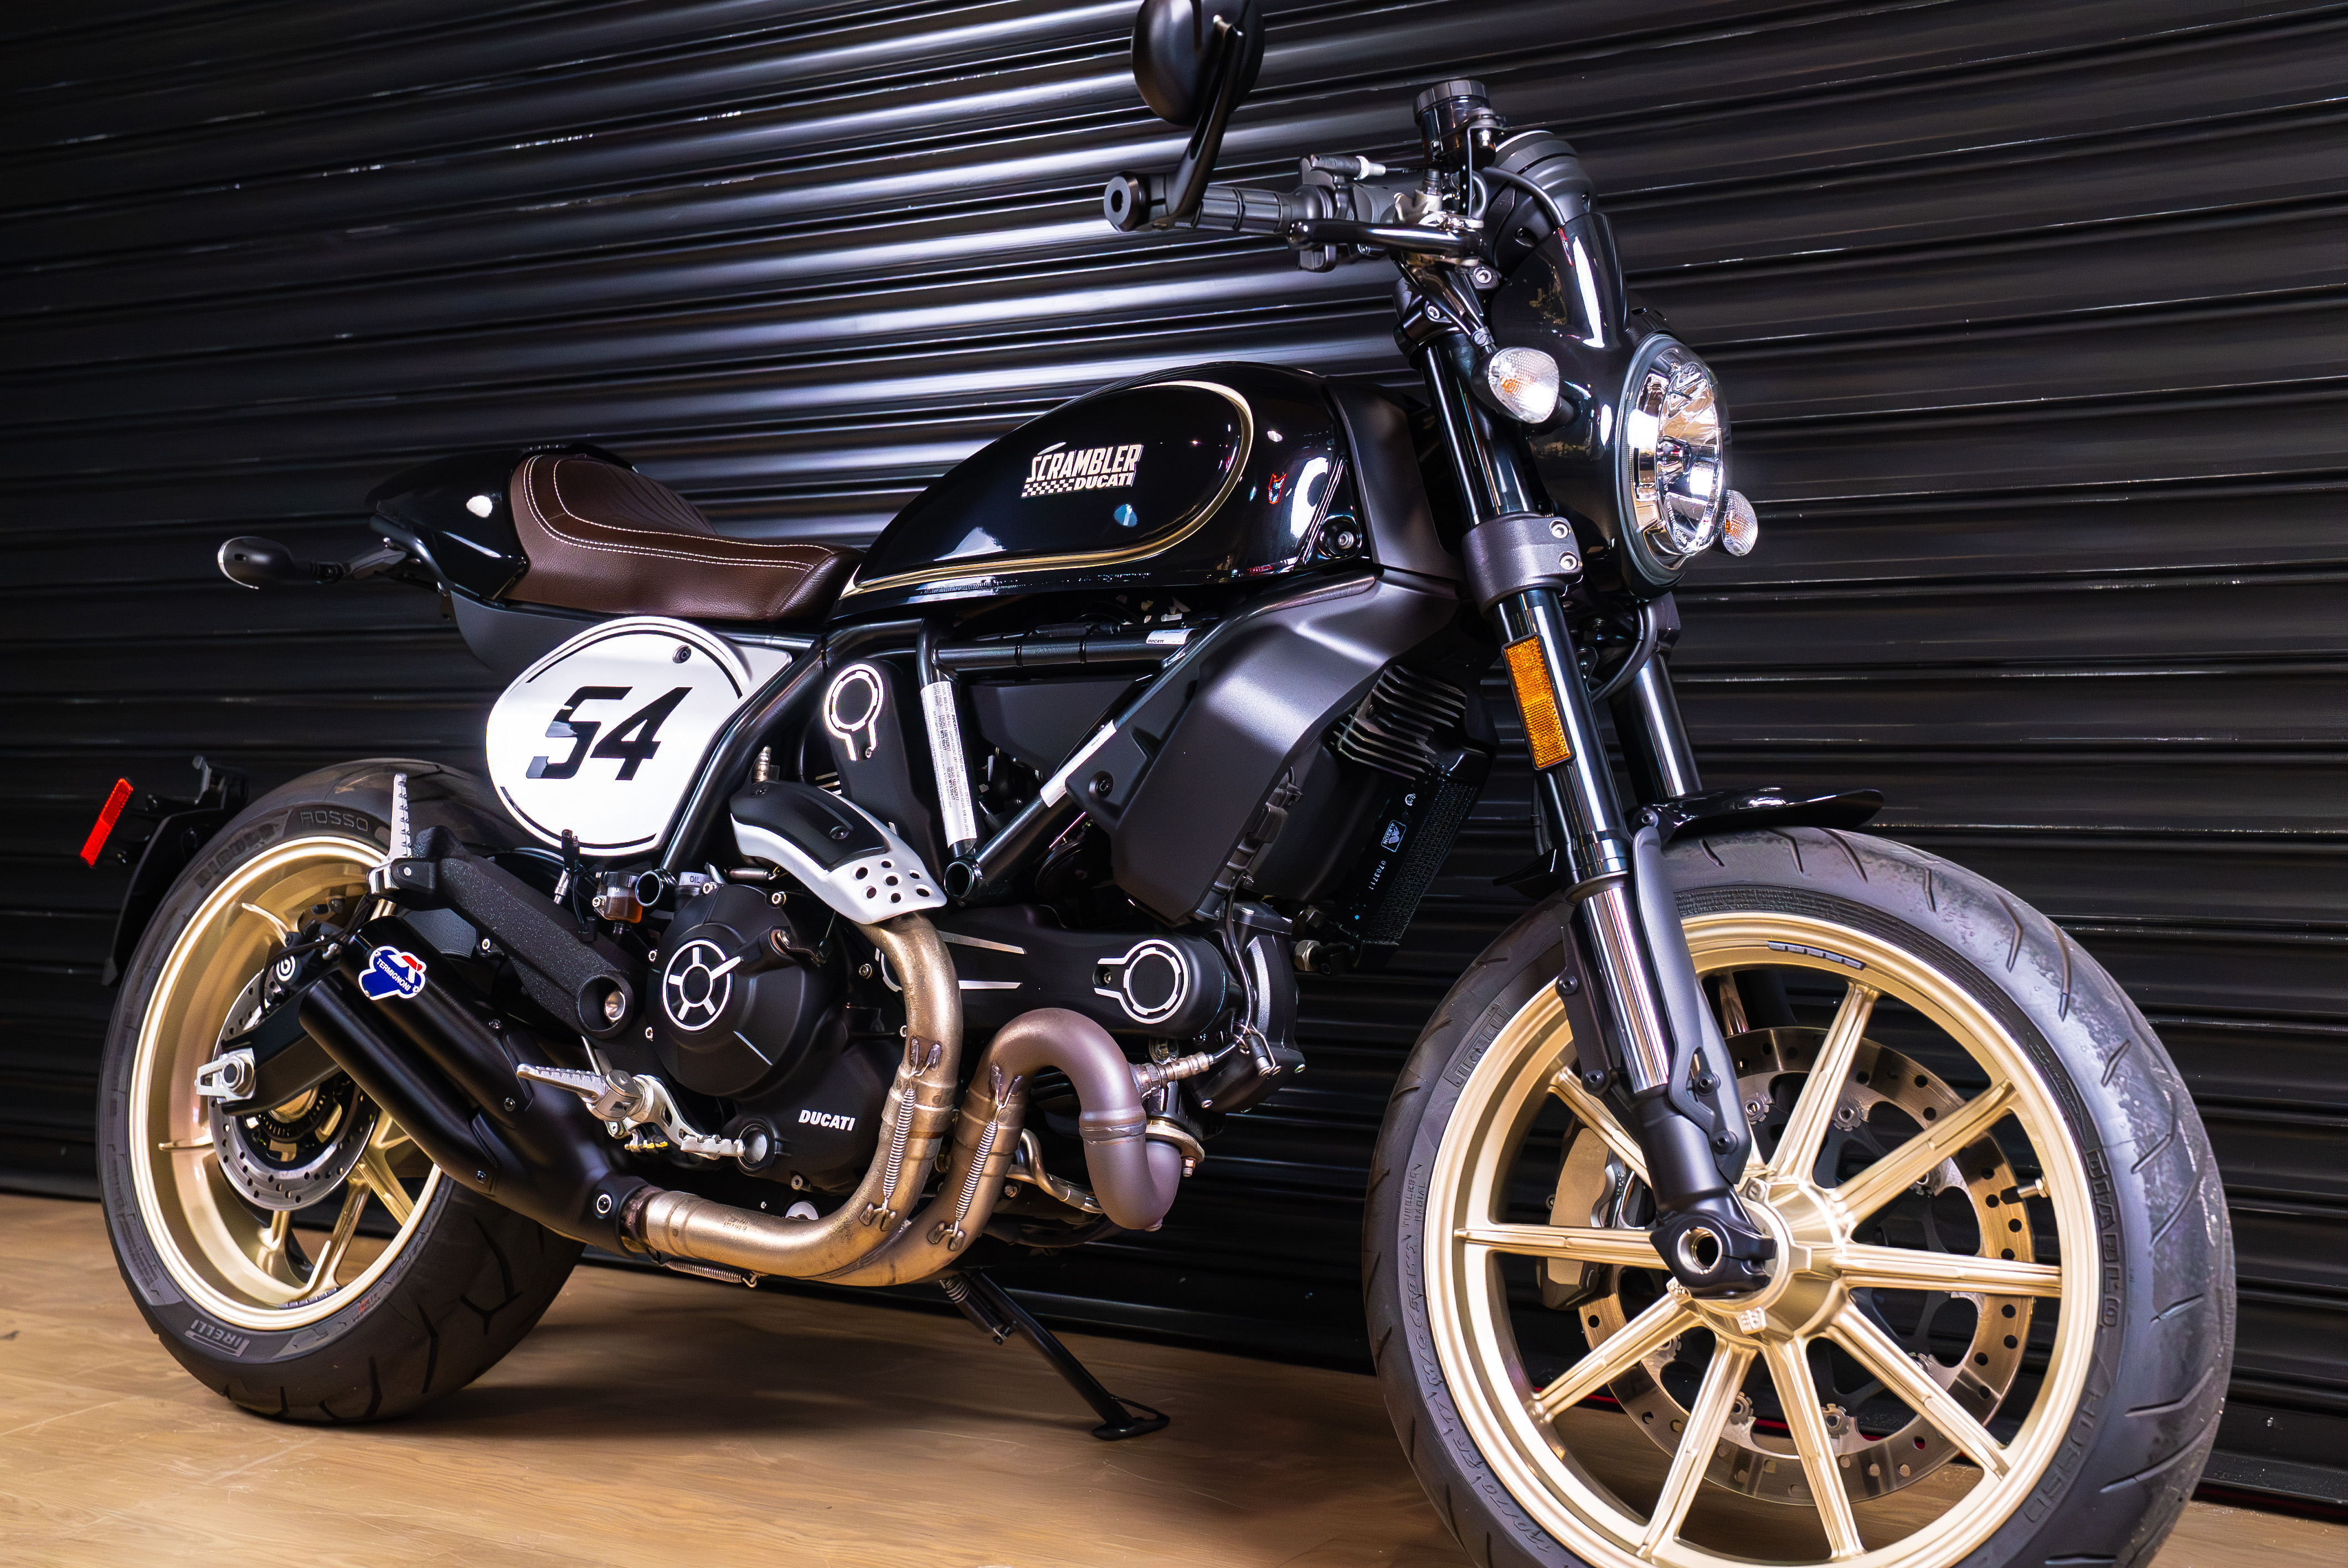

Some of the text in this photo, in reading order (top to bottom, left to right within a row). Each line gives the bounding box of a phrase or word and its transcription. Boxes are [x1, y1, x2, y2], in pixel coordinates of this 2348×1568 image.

[1025, 444, 1142, 483] SCRAMBLER
[1073, 472, 1135, 491] DUCATI
[526, 685, 693, 781] 54
[689, 875, 701, 884] OIL
[1368, 860, 1387, 890] 0703711
[376, 958, 412, 992] TERMIGNONI
[798, 1109, 856, 1131] DUCATI
[184, 1318, 250, 1358] PIRELLI
